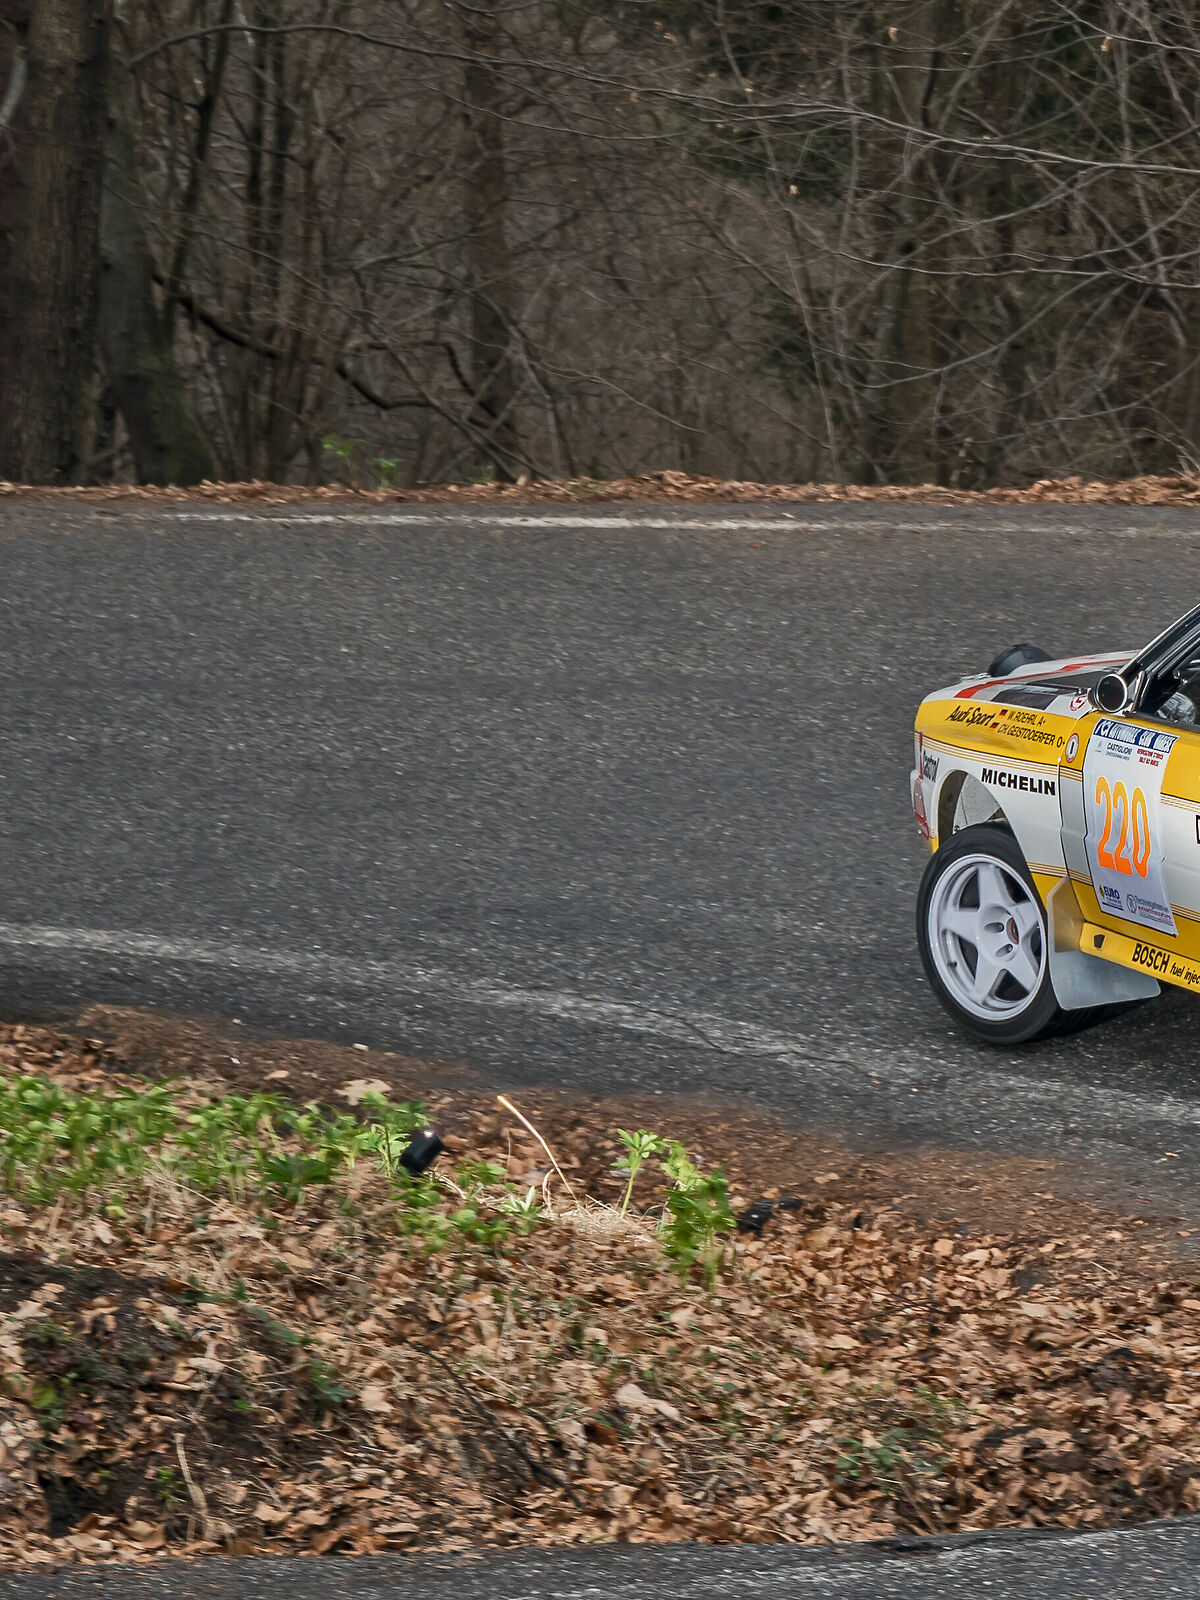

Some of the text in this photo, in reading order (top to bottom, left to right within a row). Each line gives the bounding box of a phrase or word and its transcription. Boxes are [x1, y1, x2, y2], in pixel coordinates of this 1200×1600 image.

[945, 705, 996, 727] Audi Sport
[981, 768, 1055, 796] MICHELIN
[1095, 776, 1150, 878] 220
[1103, 886, 1120, 899] EURO
[1132, 943, 1170, 974] BOSCH
[1169, 962, 1184, 977] fuel
